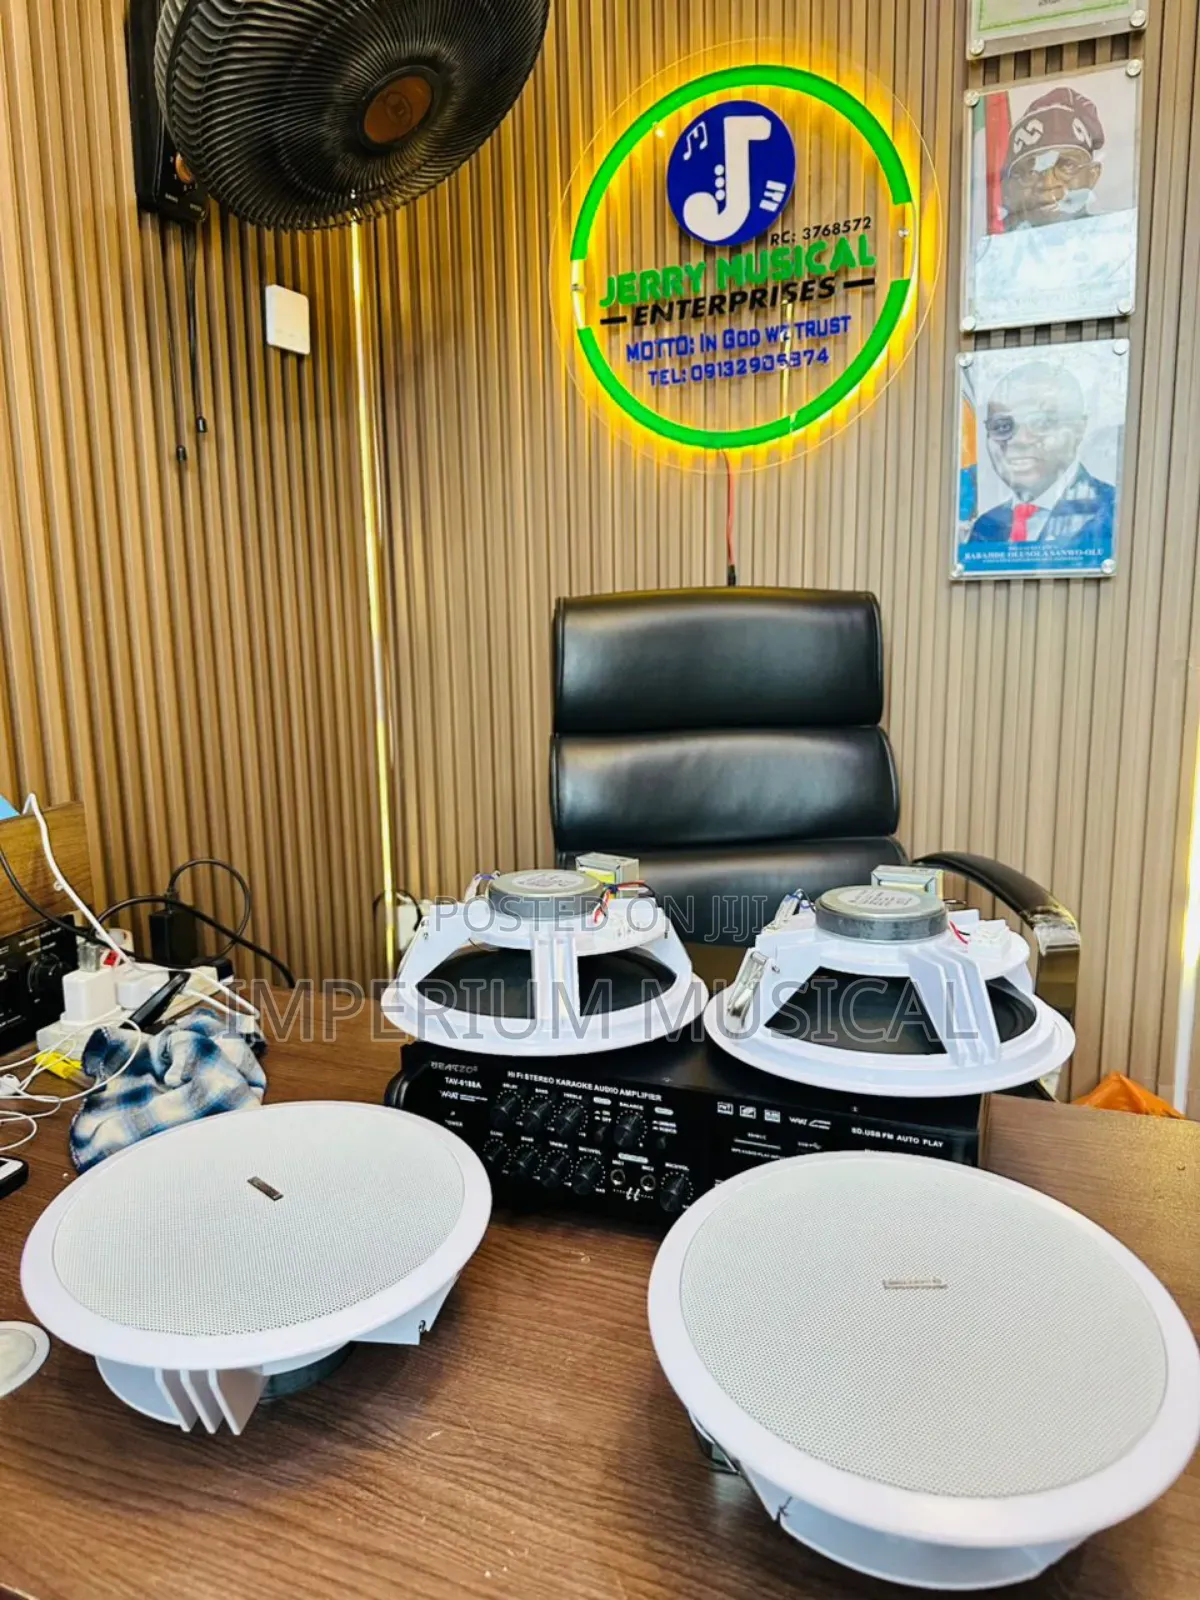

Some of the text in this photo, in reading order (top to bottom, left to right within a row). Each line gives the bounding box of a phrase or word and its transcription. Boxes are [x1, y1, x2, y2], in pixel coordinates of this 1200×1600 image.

[770, 216, 872, 246] RC: 3768572
[599, 233, 876, 308] JERRY MUSICAL
[633, 276, 836, 326] ENTERPRISES
[626, 335, 695, 362] MOTTO:
[794, 315, 851, 341] TRUST
[524, 1073, 555, 1085] STEREO
[556, 1078, 593, 1091] KARAOKE
[594, 1084, 618, 1095] AUDIO
[619, 1088, 662, 1102] AMPLIFIER
[896, 1134, 920, 1144] AUTO
[922, 1138, 944, 1148] PLAY
